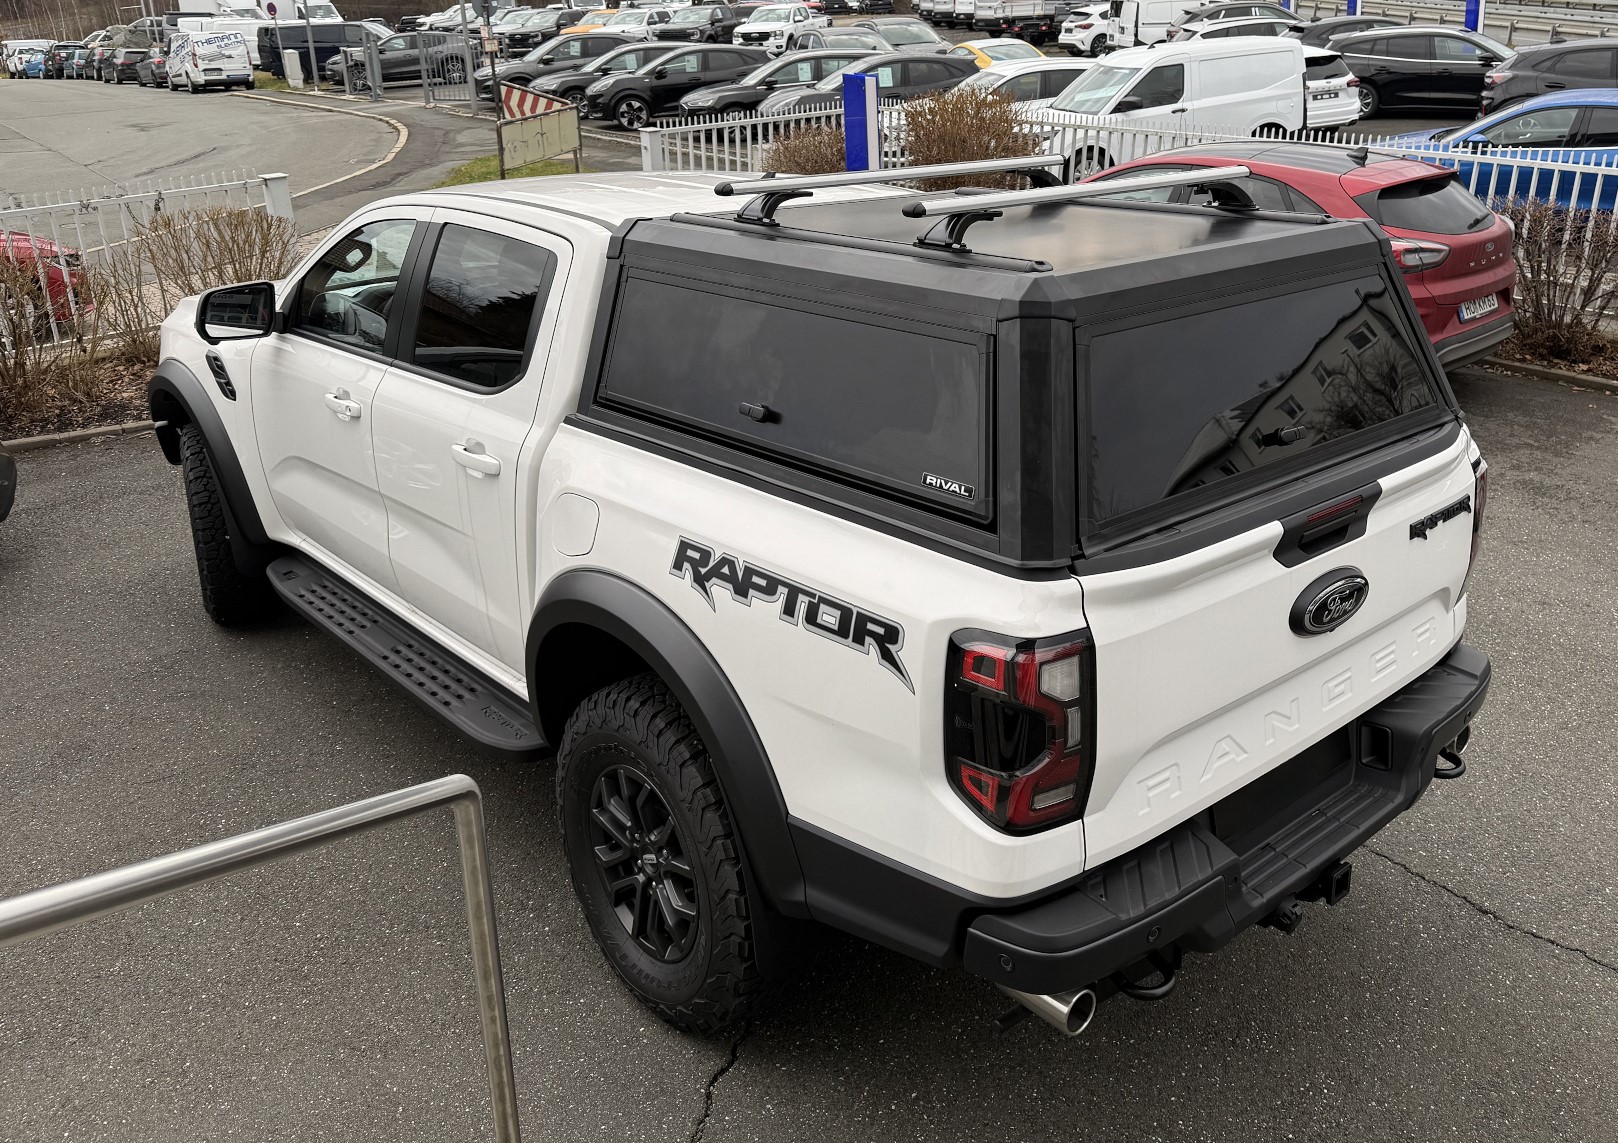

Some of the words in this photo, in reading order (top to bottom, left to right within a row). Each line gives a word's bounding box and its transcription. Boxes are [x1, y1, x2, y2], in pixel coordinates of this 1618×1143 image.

[925, 475, 969, 496] RIVAL
[1409, 492, 1472, 541] RAPTOR
[669, 535, 916, 696] RAPTOR
[1323, 589, 1358, 623] Ford
[1136, 616, 1437, 816] RANGER
